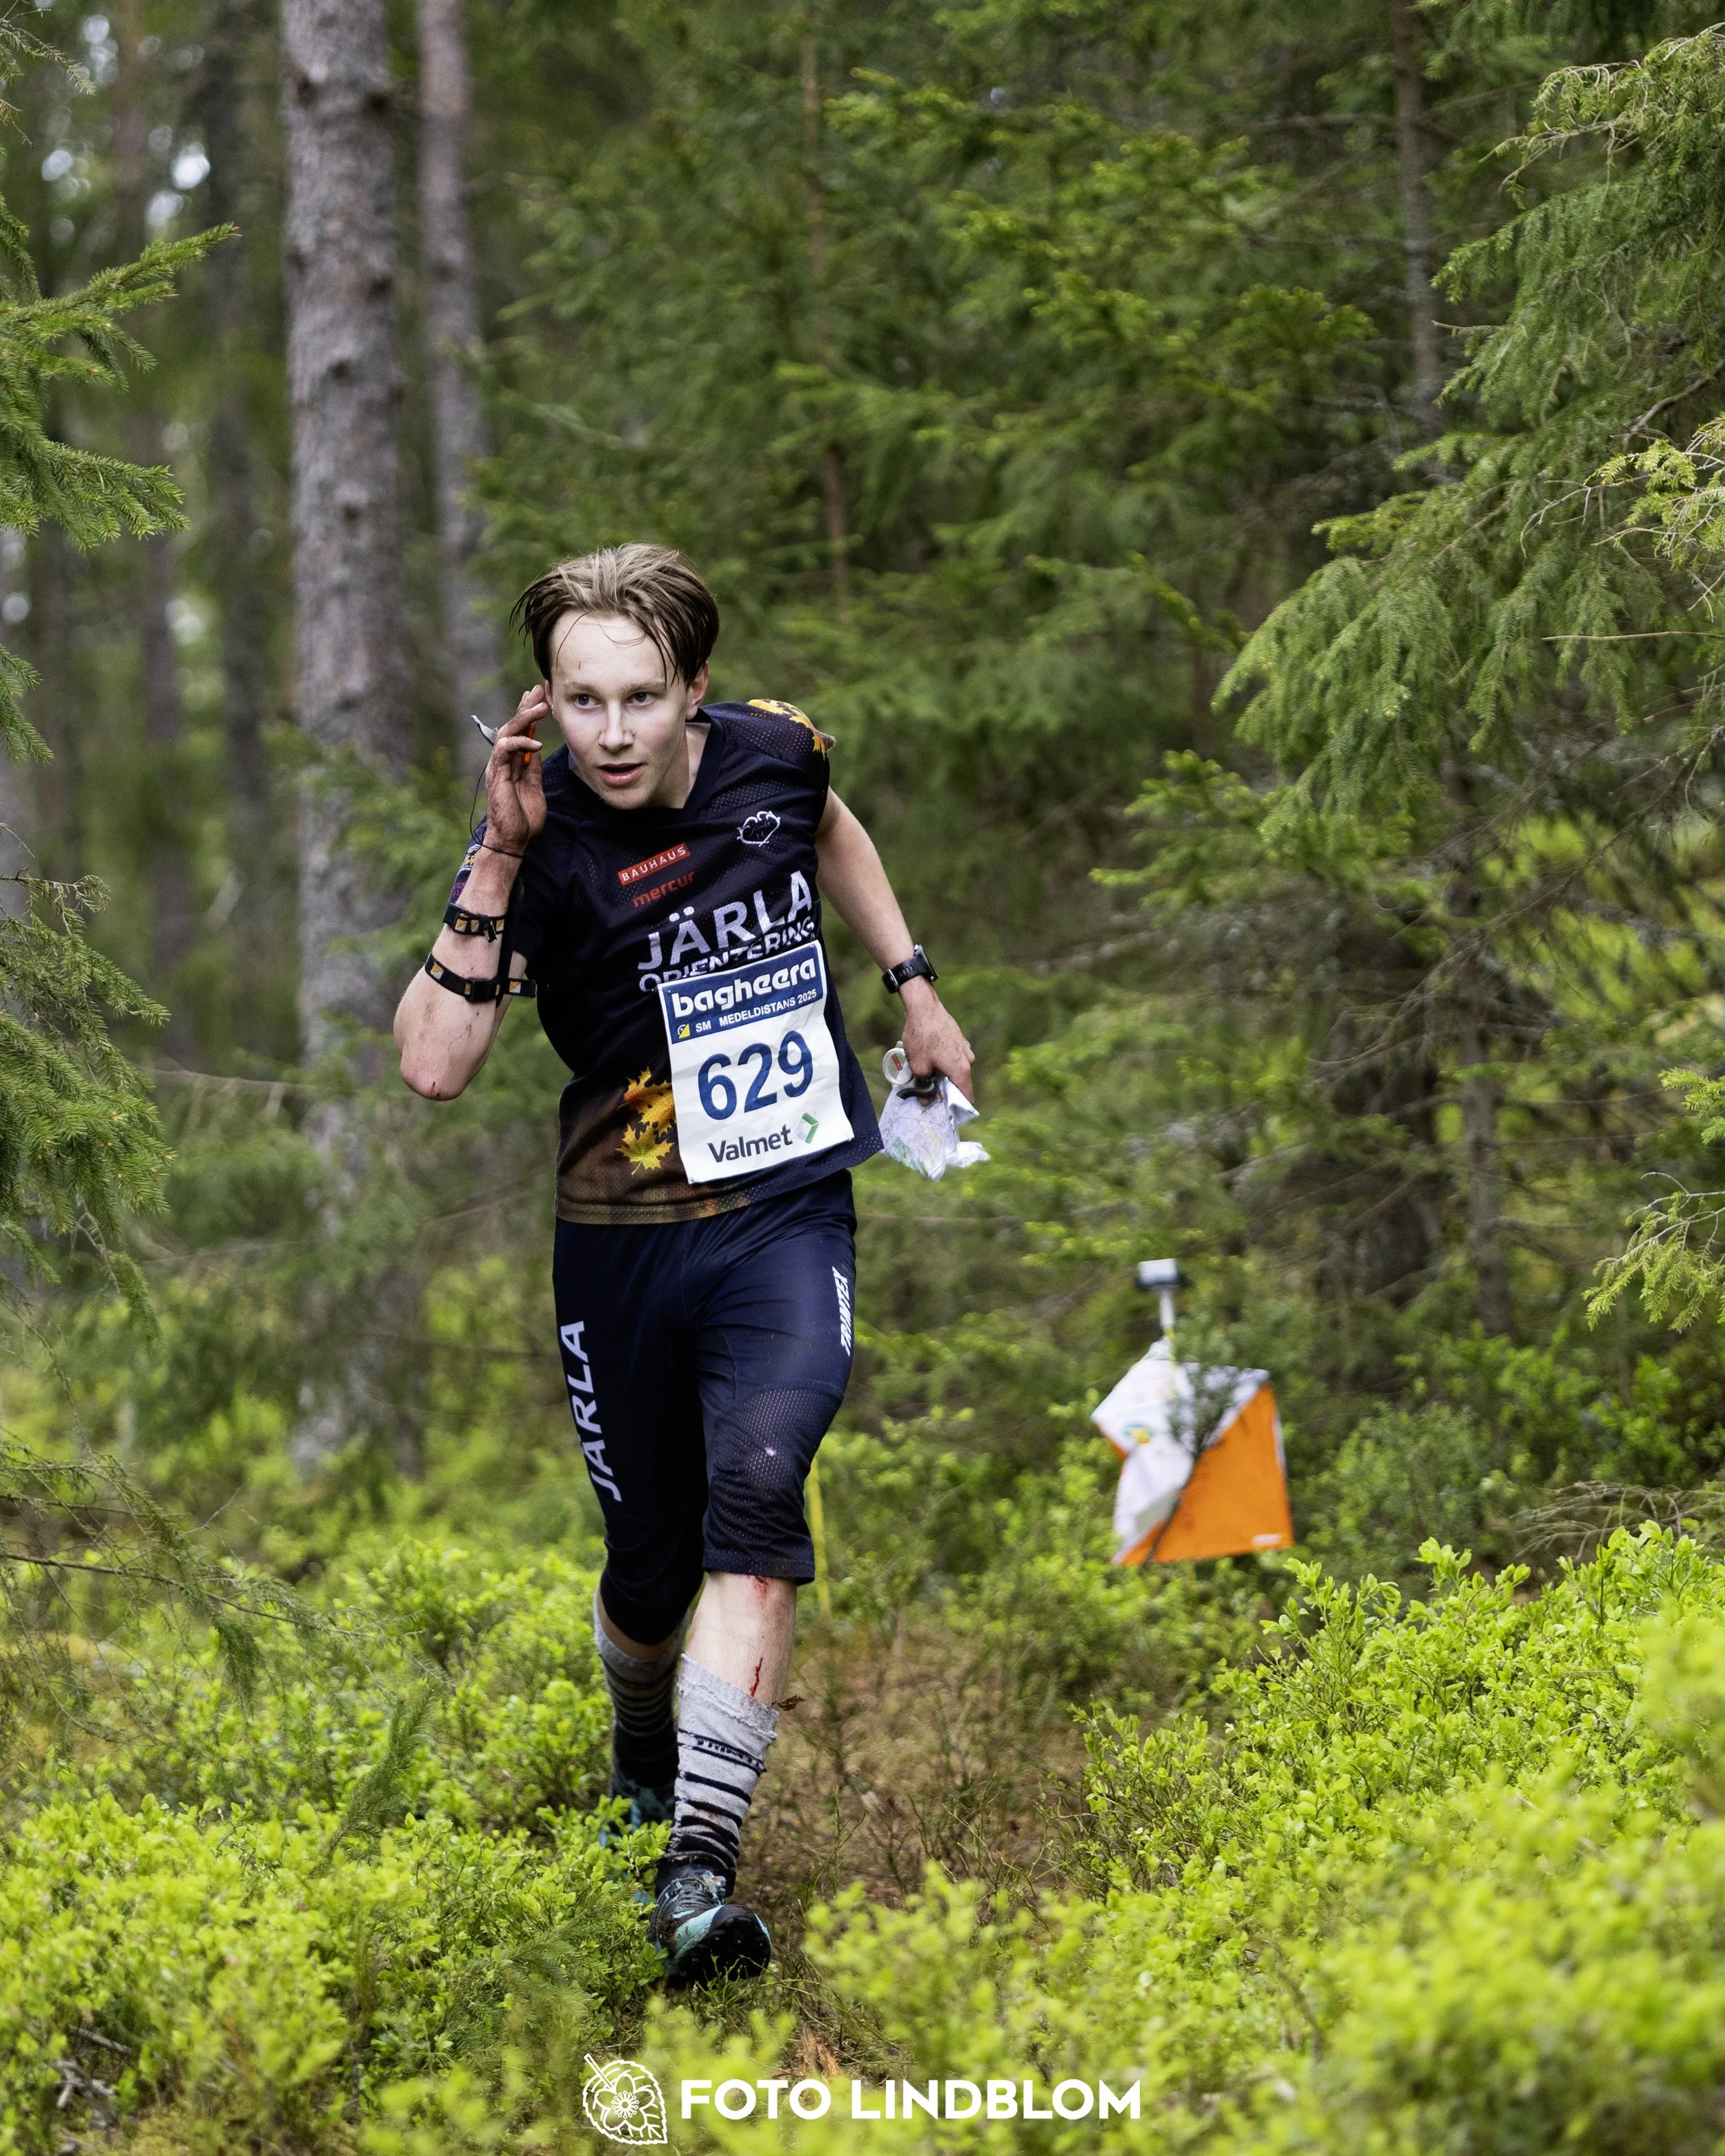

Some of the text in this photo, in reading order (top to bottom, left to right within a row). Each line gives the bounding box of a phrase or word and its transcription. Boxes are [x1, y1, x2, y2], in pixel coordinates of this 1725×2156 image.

[621, 844, 686, 881] BAUHAUS
[633, 871, 694, 907] mercur
[638, 870, 812, 970] JÄRLA
[671, 958, 816, 1018] bagheera
[696, 989, 817, 1032] SM MEDELDISTANS 2025
[698, 1030, 814, 1120] 629
[708, 1125, 793, 1163] Valmet
